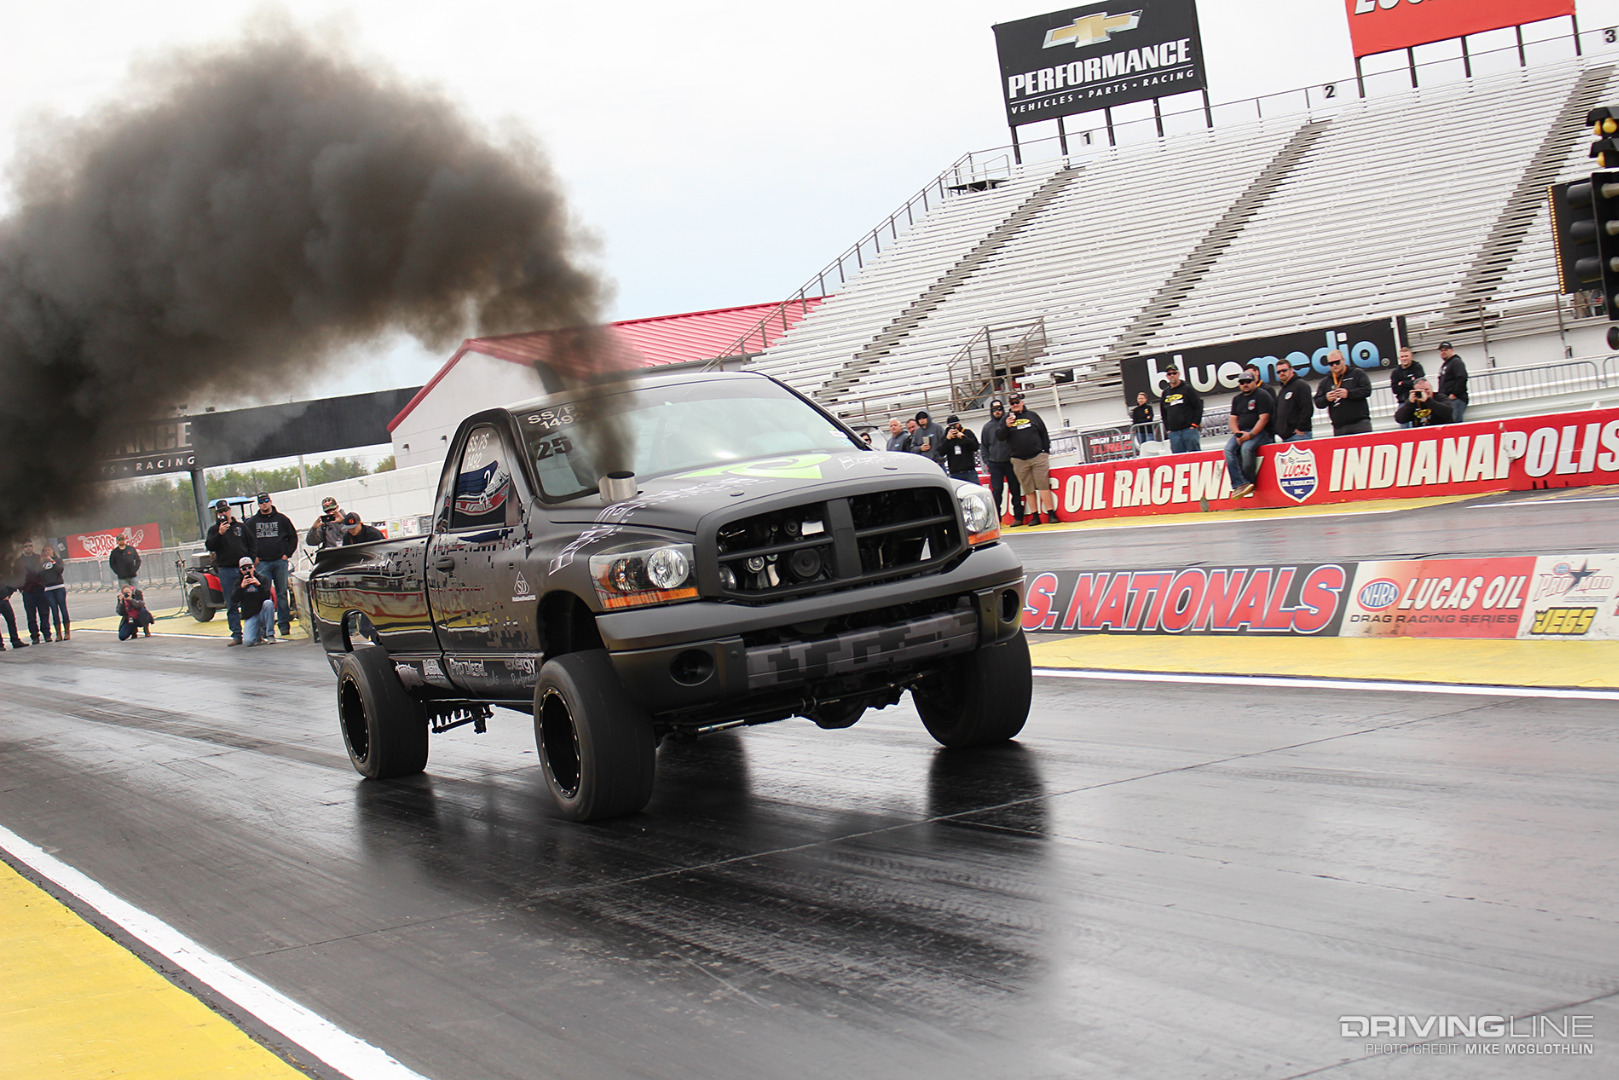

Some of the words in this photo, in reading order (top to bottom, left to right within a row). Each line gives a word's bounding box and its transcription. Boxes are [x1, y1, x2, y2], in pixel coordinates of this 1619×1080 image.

[1604, 28, 1618, 43] 3
[1008, 37, 1191, 99] PERFORMANCE
[1011, 94, 1074, 115] VEHICLES
[1088, 82, 1128, 98] PARTS
[1143, 69, 1195, 87] RACING
[1324, 85, 1336, 99] 2
[1083, 132, 1091, 145] 1
[1146, 330, 1382, 399] bluemedia
[535, 436, 574, 461] 25
[135, 456, 196, 472] RACING
[1282, 463, 1312, 478] LUCAS
[1064, 472, 1107, 513] OIL
[1060, 564, 1347, 635] NATIONALS
[1360, 582, 1399, 608] NHRA
[1397, 576, 1485, 611] LUCAS
[1481, 575, 1528, 609] OIL
[1532, 573, 1574, 602] PRO
[1575, 575, 1615, 592] MOD
[1350, 614, 1393, 624] DRAG
[1396, 614, 1458, 624] RACING
[1460, 613, 1518, 624] SERIES
[1528, 607, 1598, 636] JEGS
